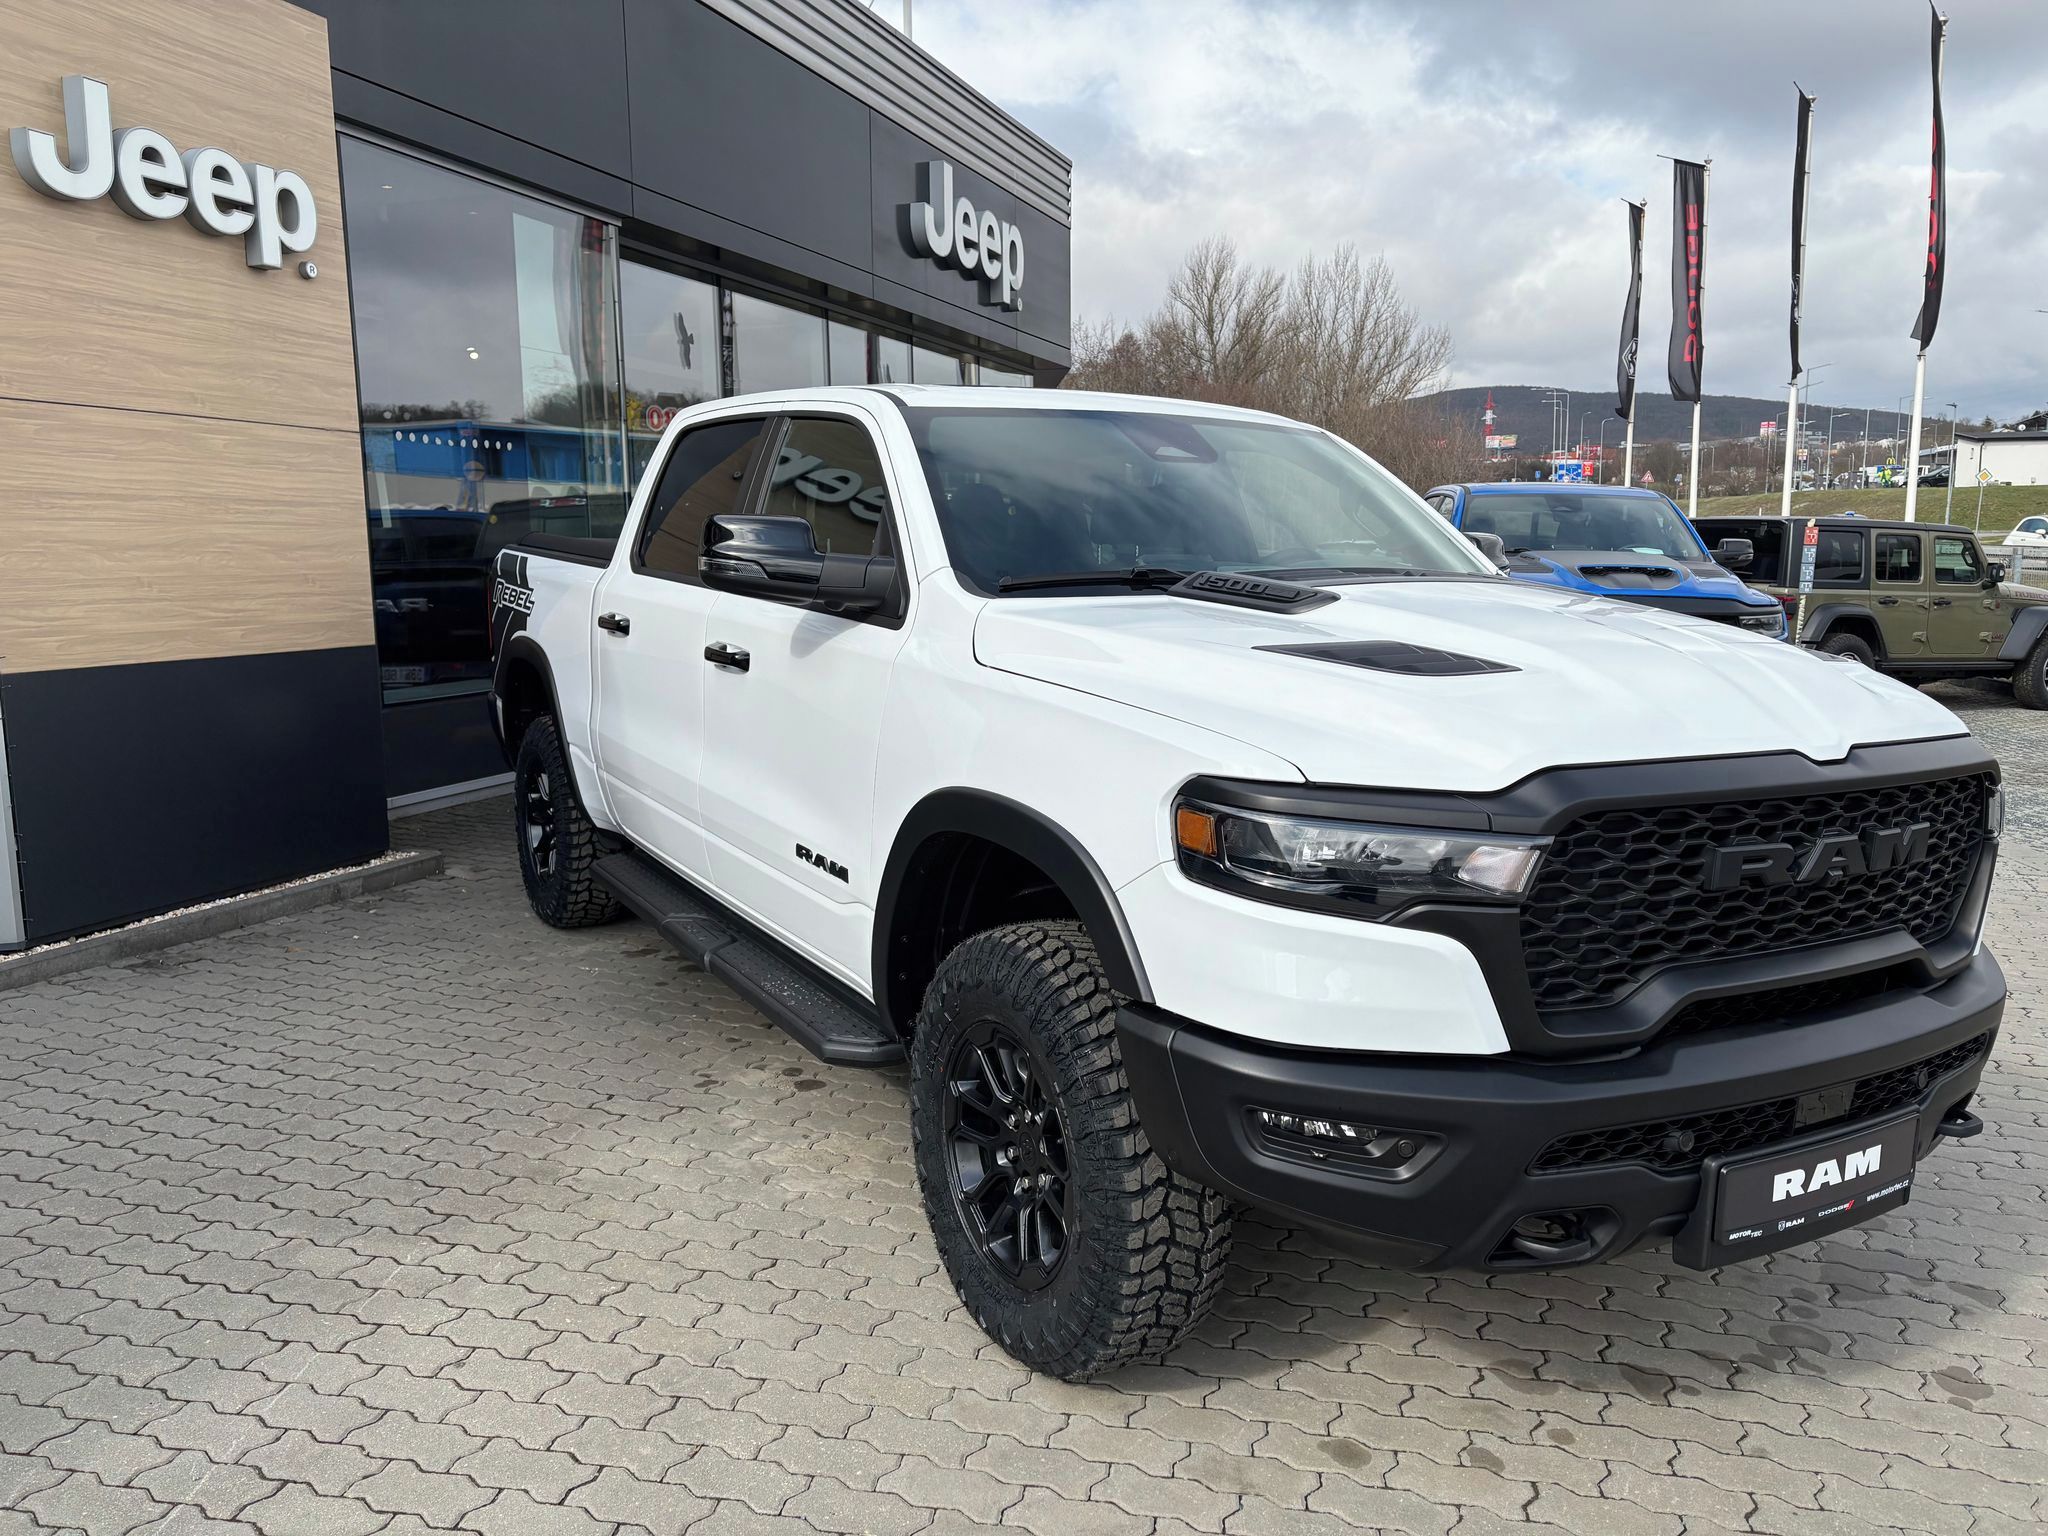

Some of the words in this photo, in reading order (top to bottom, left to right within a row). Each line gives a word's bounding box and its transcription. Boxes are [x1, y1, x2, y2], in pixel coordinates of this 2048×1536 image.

[9, 74, 317, 270] Jeep
[908, 160, 1025, 305] Jeep
[492, 577, 534, 614] REBEL
[1192, 574, 1269, 594] 1500
[795, 842, 849, 884] RAM
[1704, 821, 1931, 890] RAM
[1771, 1144, 1882, 1203] RAM
[1785, 1217, 1805, 1228] RAM
